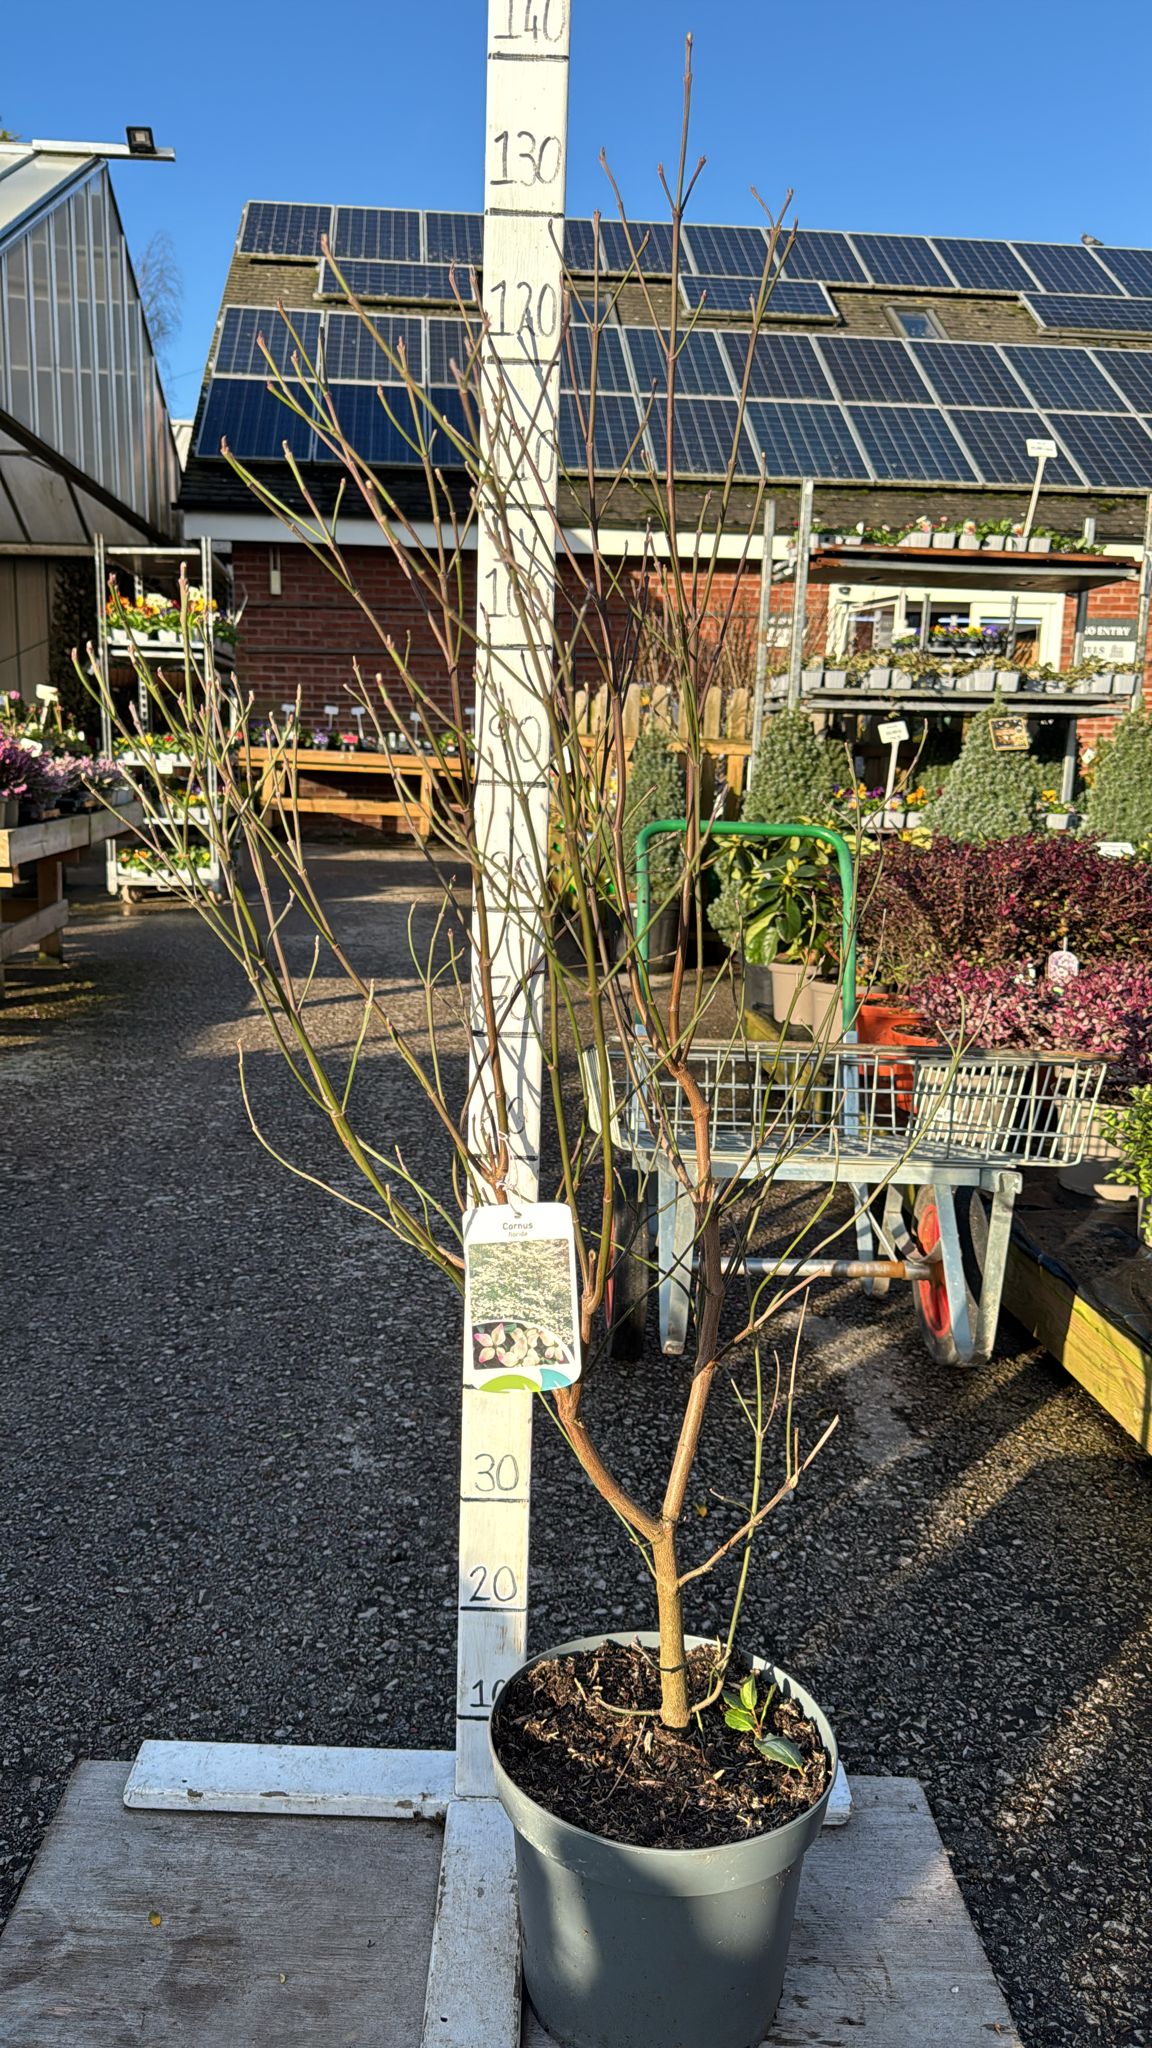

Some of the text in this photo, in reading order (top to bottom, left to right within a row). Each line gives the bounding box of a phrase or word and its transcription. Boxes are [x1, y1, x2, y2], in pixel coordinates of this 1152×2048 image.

[494, 0, 567, 42] 140
[490, 131, 562, 186] 130
[490, 280, 557, 337] 120
[1097, 626, 1131, 637] ENTRY
[502, 1222, 533, 1231] Cornus
[474, 1453, 519, 1492] 30
[469, 1566, 518, 1602] 20
